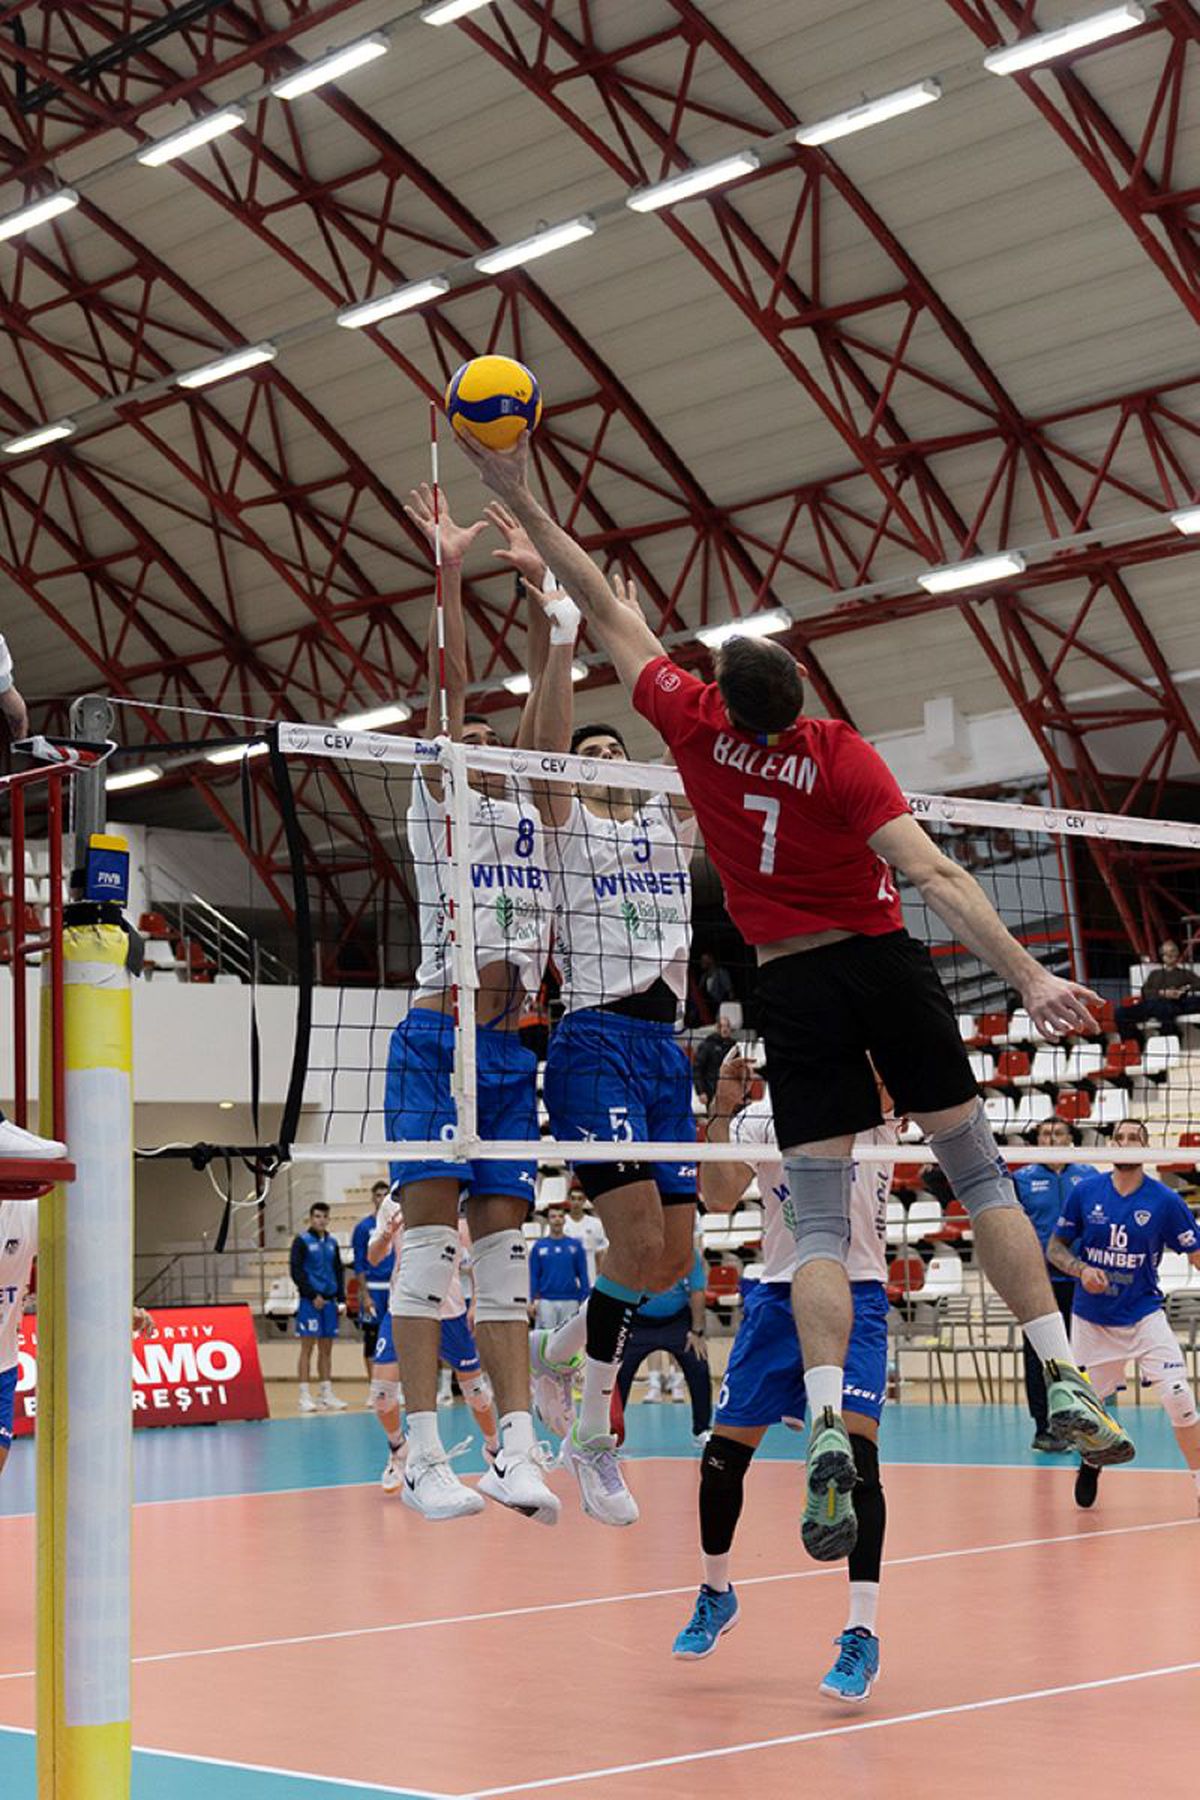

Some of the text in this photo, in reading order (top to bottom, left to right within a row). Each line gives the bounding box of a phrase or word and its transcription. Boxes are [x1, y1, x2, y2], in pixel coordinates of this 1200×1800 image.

[324, 734, 353, 749] CEV
[541, 758, 566, 773] CEV
[713, 732, 818, 795] BALEAN
[909, 798, 931, 813] CEV
[743, 793, 780, 876] 7
[1065, 816, 1086, 829] CEV
[515, 818, 535, 858] 8
[592, 871, 688, 898] WINBET
[608, 1107, 633, 1143] 5
[1110, 1224, 1128, 1248] 16
[1085, 1247, 1147, 1269] WINBET
